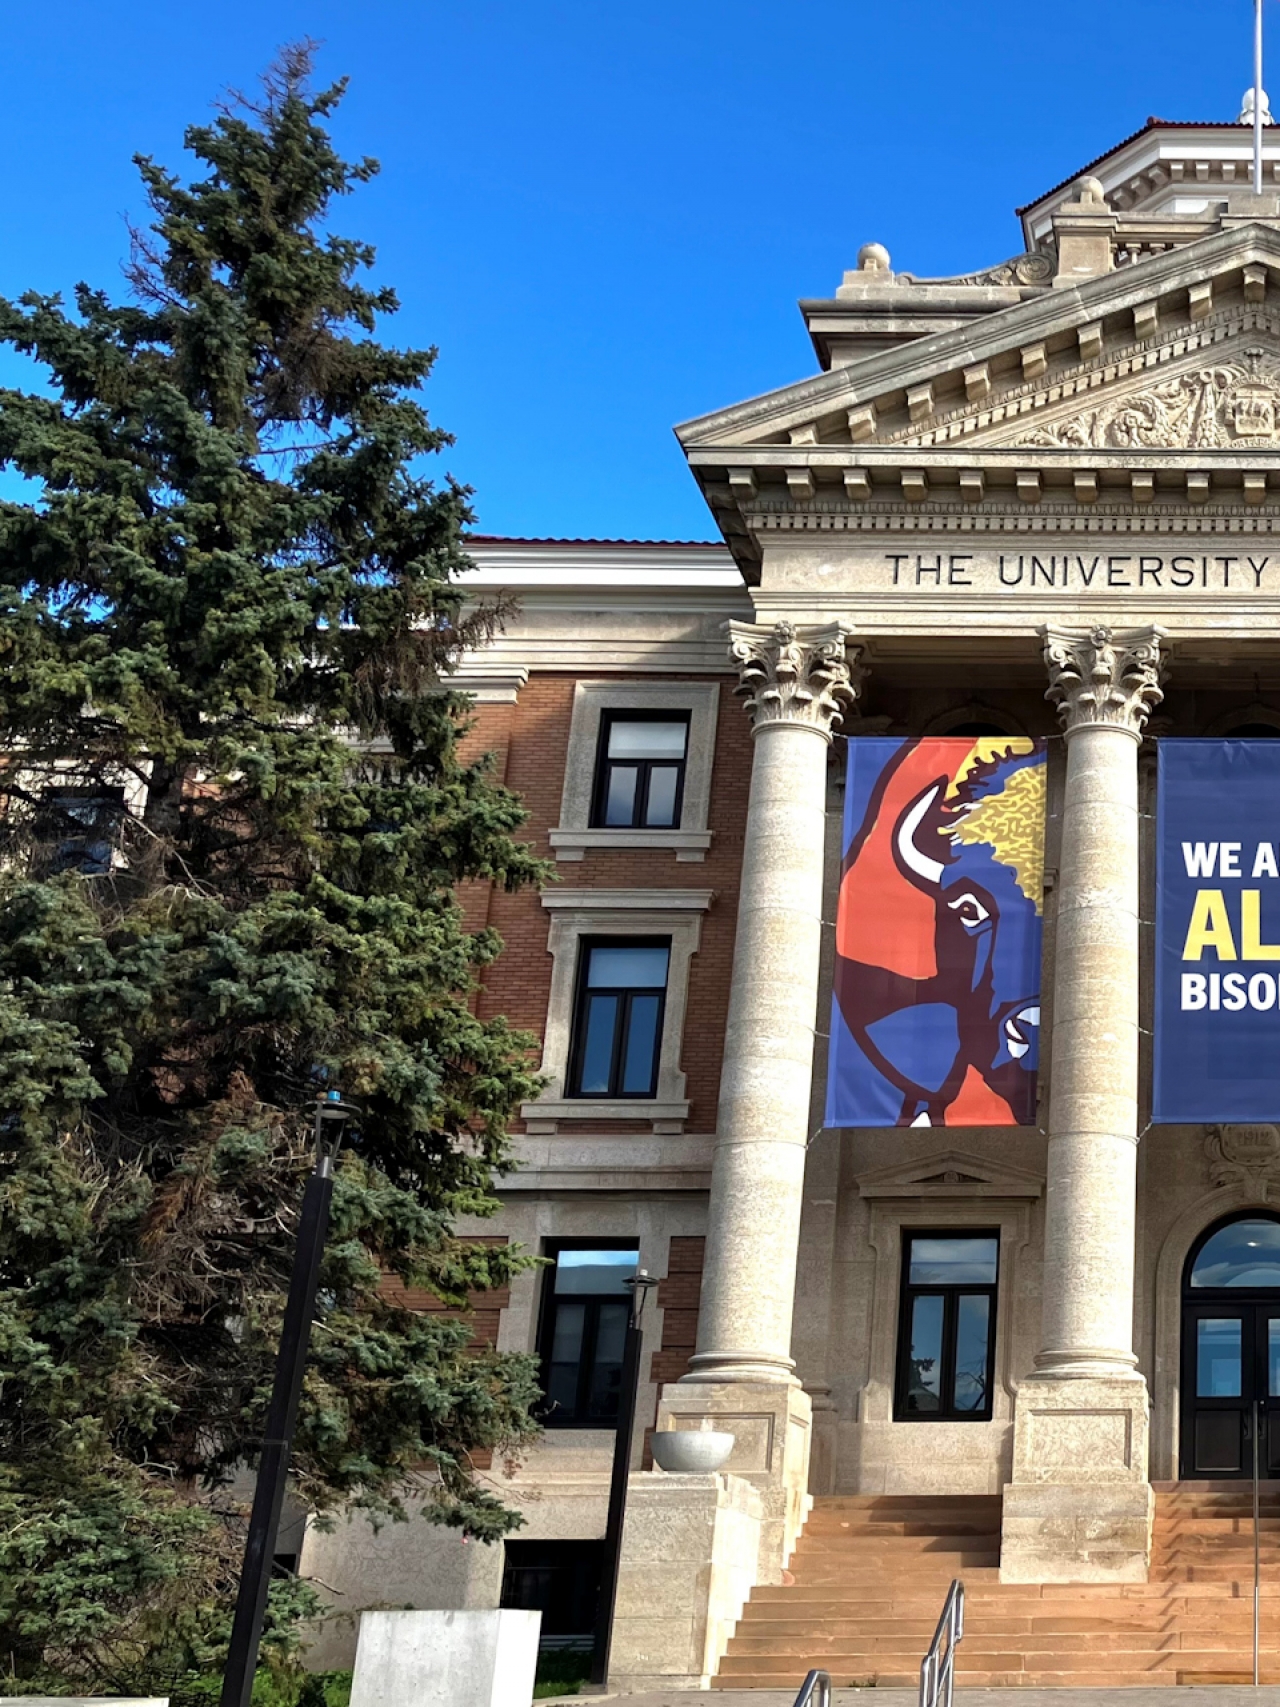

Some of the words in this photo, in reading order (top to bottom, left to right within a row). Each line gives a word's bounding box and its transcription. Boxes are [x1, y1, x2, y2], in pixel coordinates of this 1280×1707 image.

[884, 554, 973, 586] THE
[999, 555, 1269, 587] UNIVERSITY
[1181, 842, 1242, 878] WE
